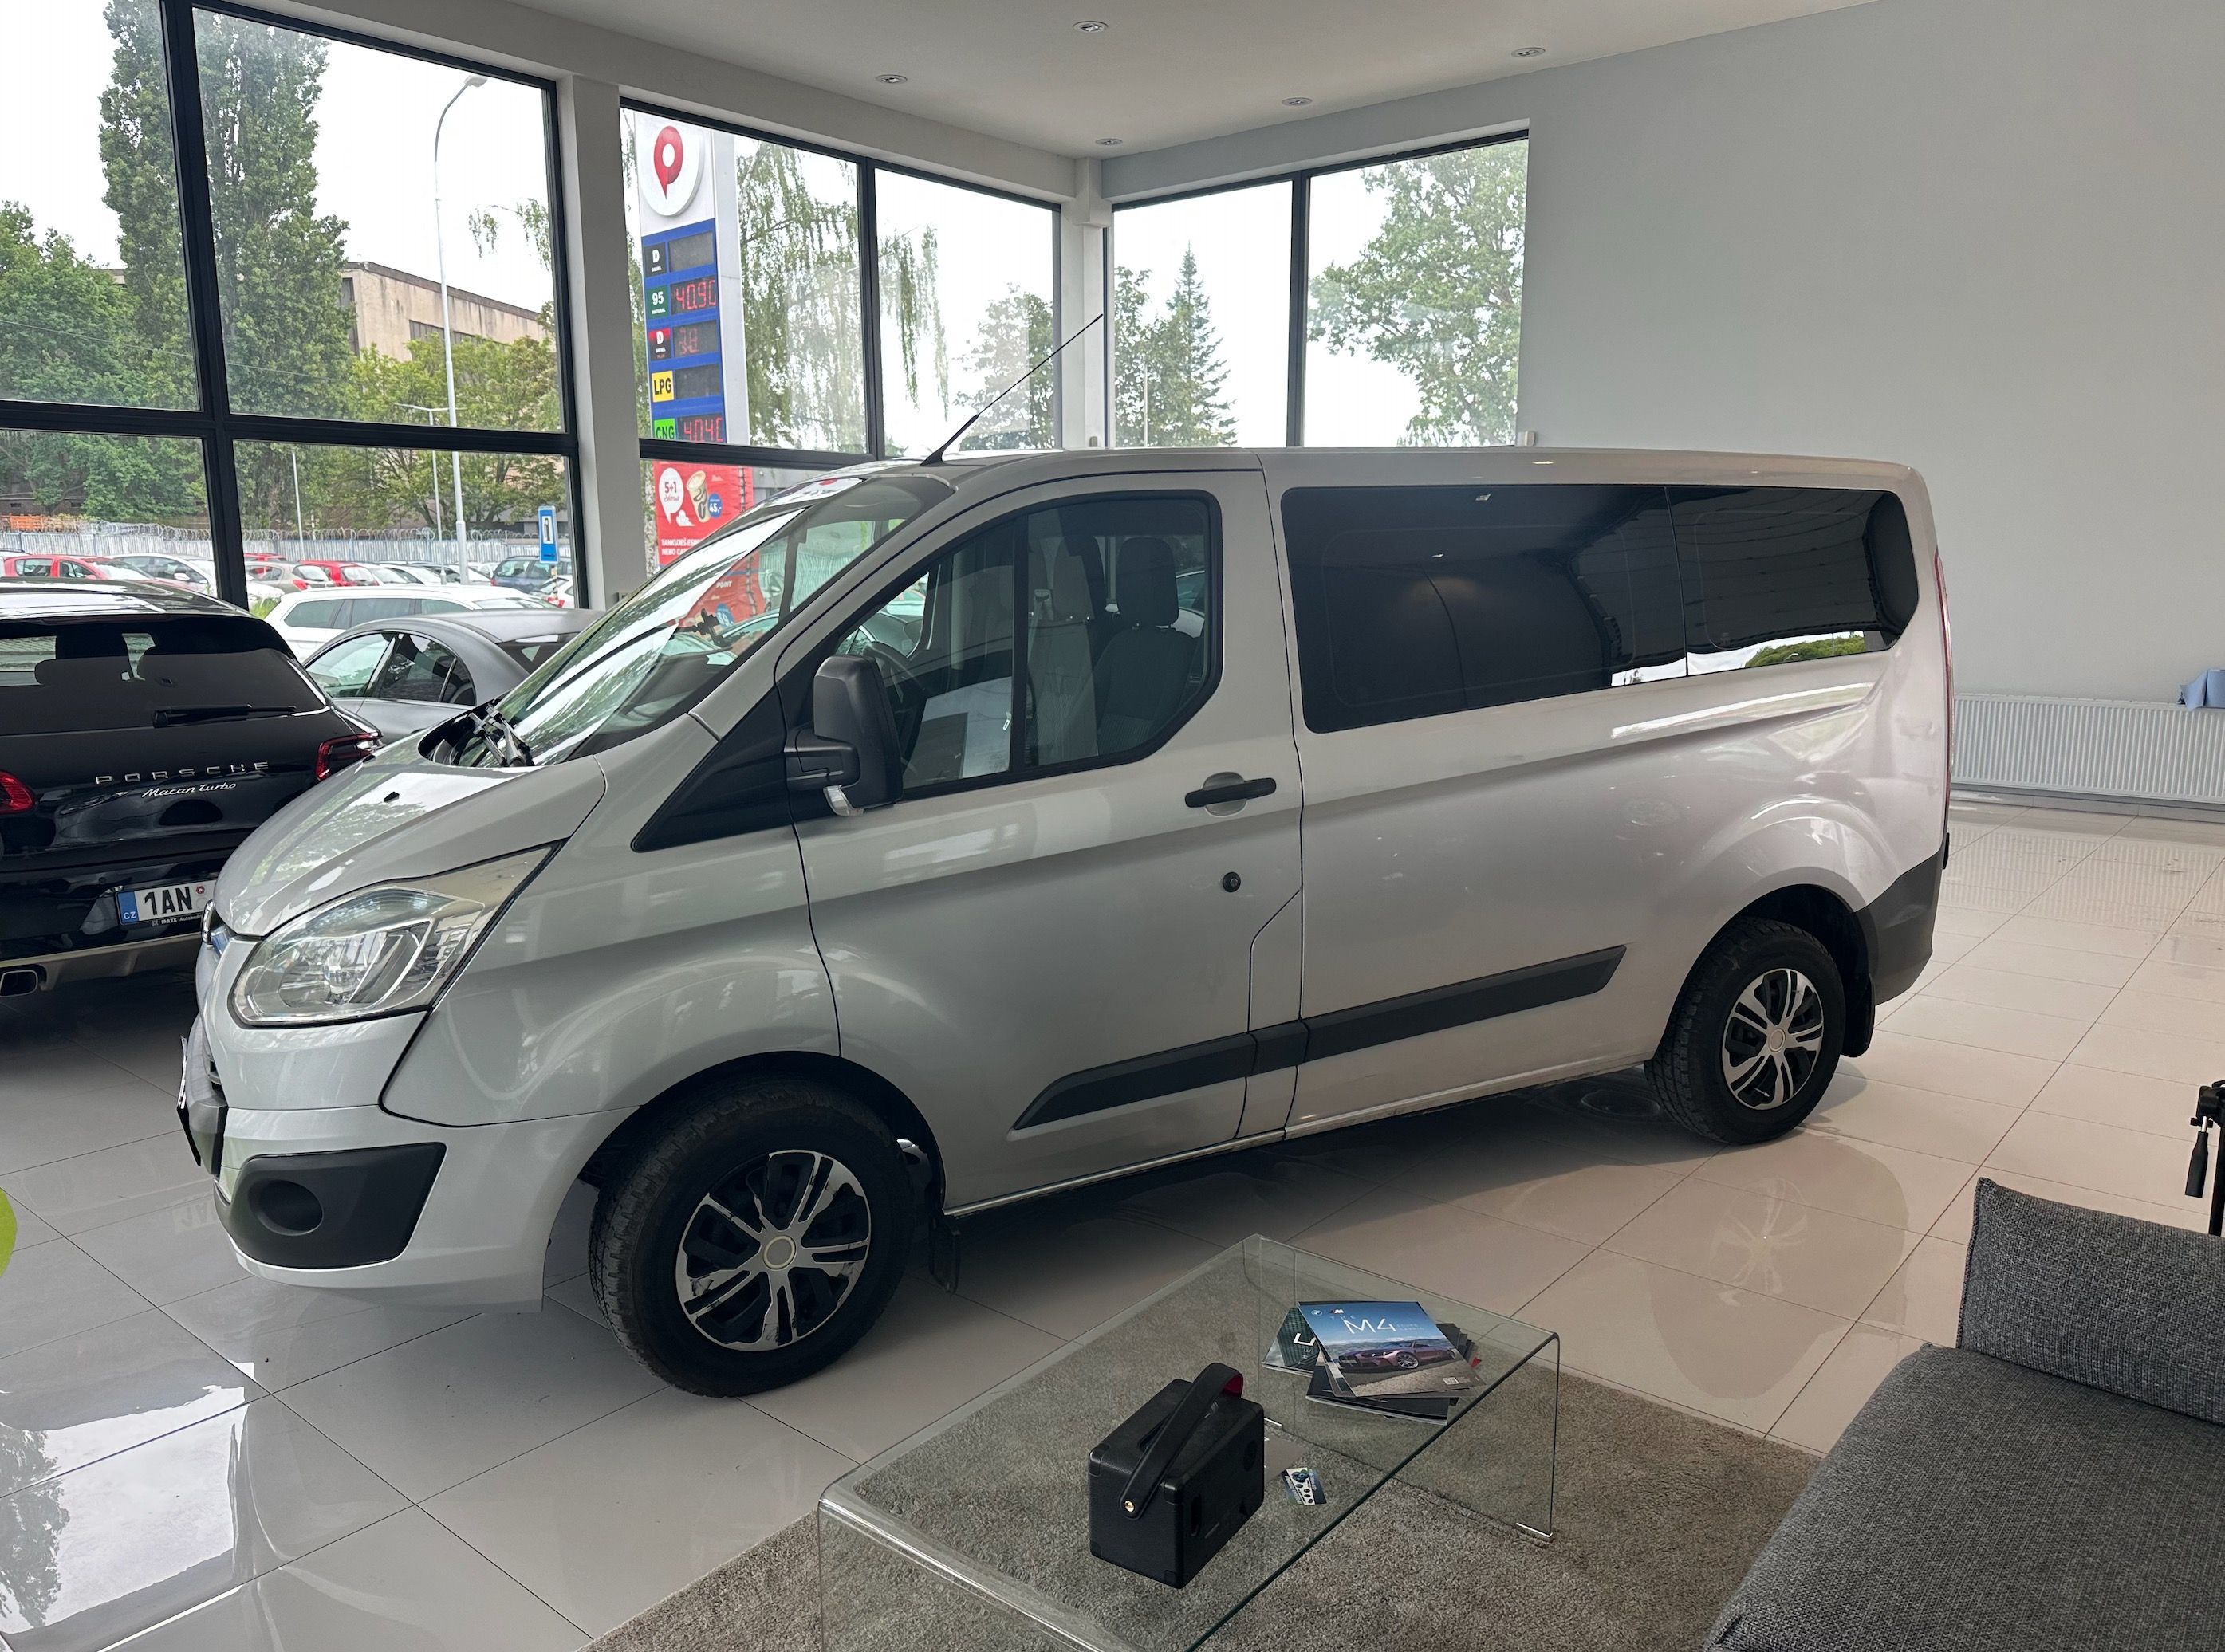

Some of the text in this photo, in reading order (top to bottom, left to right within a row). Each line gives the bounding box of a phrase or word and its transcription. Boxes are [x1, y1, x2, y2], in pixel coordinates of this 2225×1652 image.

[652, 249, 660, 263] D
[652, 291, 664, 305] 95
[656, 331, 664, 344] D
[654, 378, 672, 395] LPG
[656, 426, 675, 439] CNG
[664, 481, 677, 494] 5+1
[95, 761, 269, 785] PORSCHE
[141, 786, 196, 798] Macan
[144, 886, 193, 916] 1AN
[123, 911, 137, 920] CZ
[1343, 1317, 1397, 1335] M4
